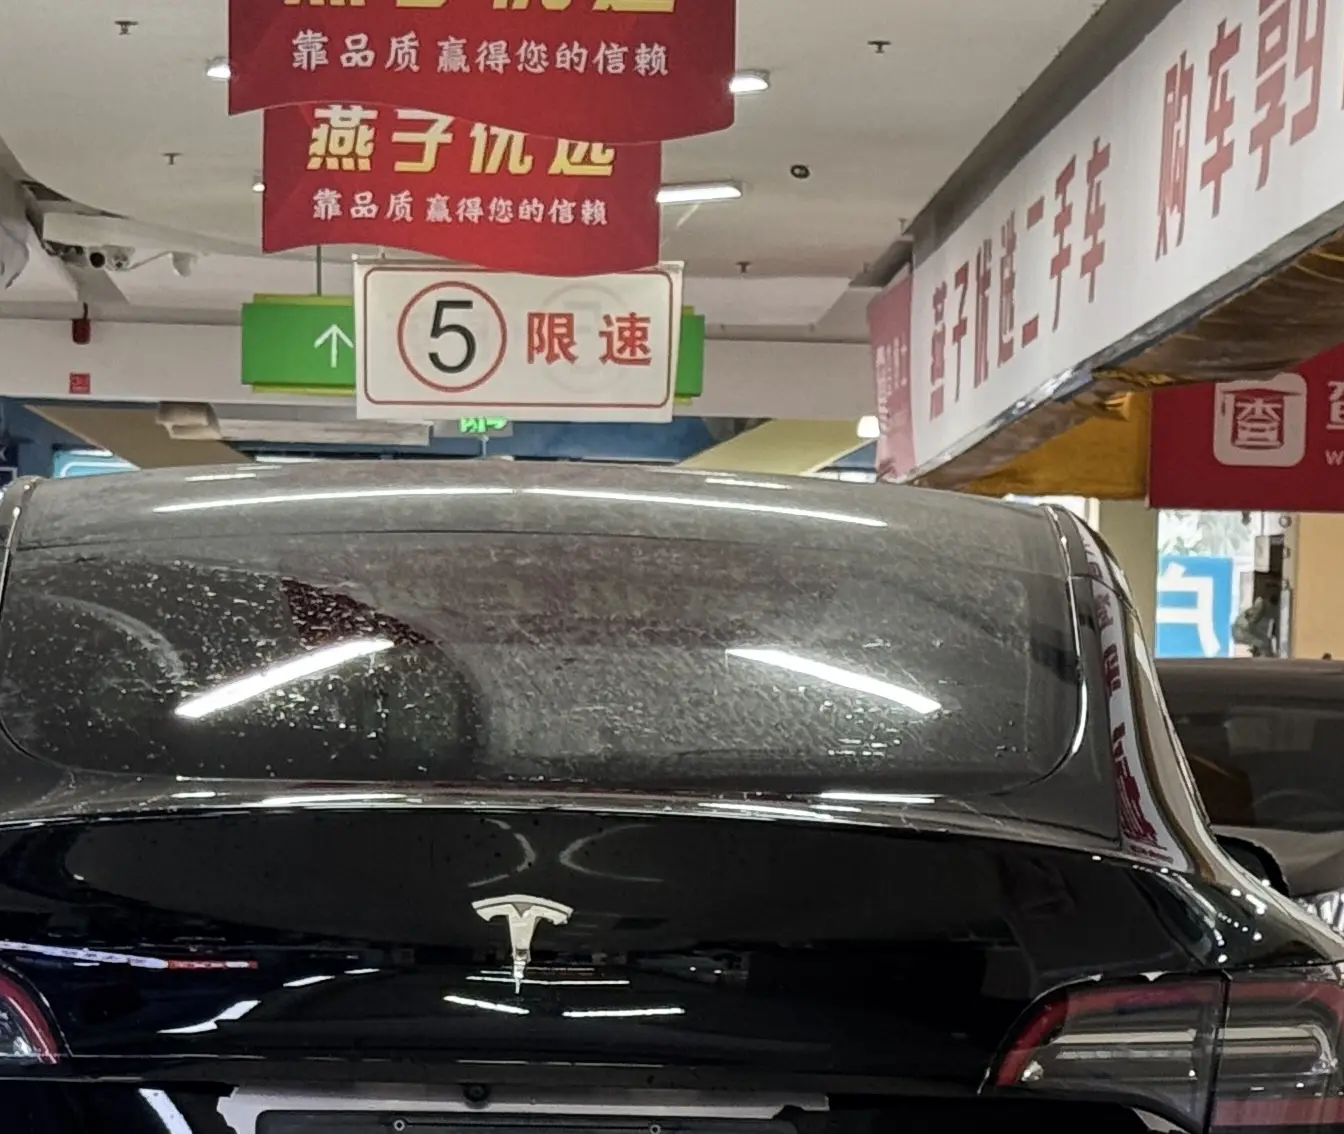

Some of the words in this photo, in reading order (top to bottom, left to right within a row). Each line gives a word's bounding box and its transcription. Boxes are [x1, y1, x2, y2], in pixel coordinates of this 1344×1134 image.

[291, 28, 421, 73] 靠品质
[436, 37, 670, 77] 赢得您的信赖
[312, 189, 414, 222] 靠品质
[426, 197, 609, 226] 赢得您的信赖
[929, 136, 1111, 420] 燕子优选二手车
[428, 300, 476, 373] 5
[527, 312, 652, 366] 限速
